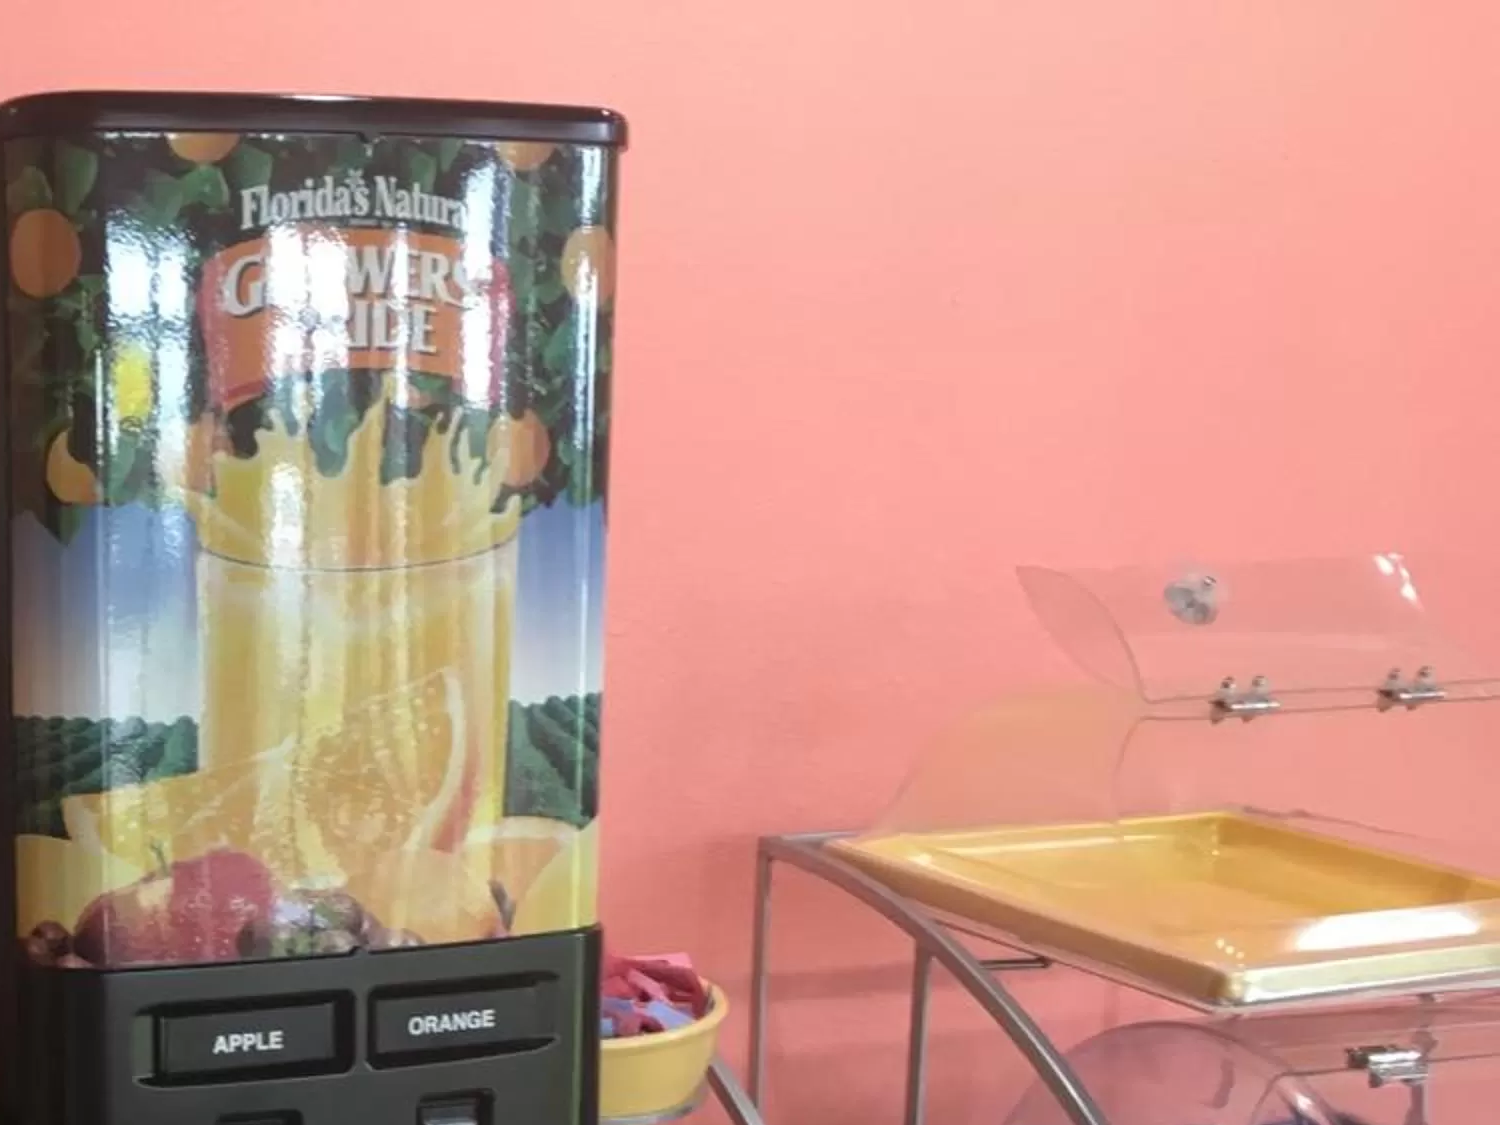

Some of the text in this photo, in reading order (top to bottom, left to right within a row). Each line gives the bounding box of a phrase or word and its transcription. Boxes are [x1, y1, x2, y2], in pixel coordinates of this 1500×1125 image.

[239, 169, 476, 233] Florida's Natura
[407, 1009, 496, 1036] ORANGE
[212, 1030, 285, 1056] APPLE
